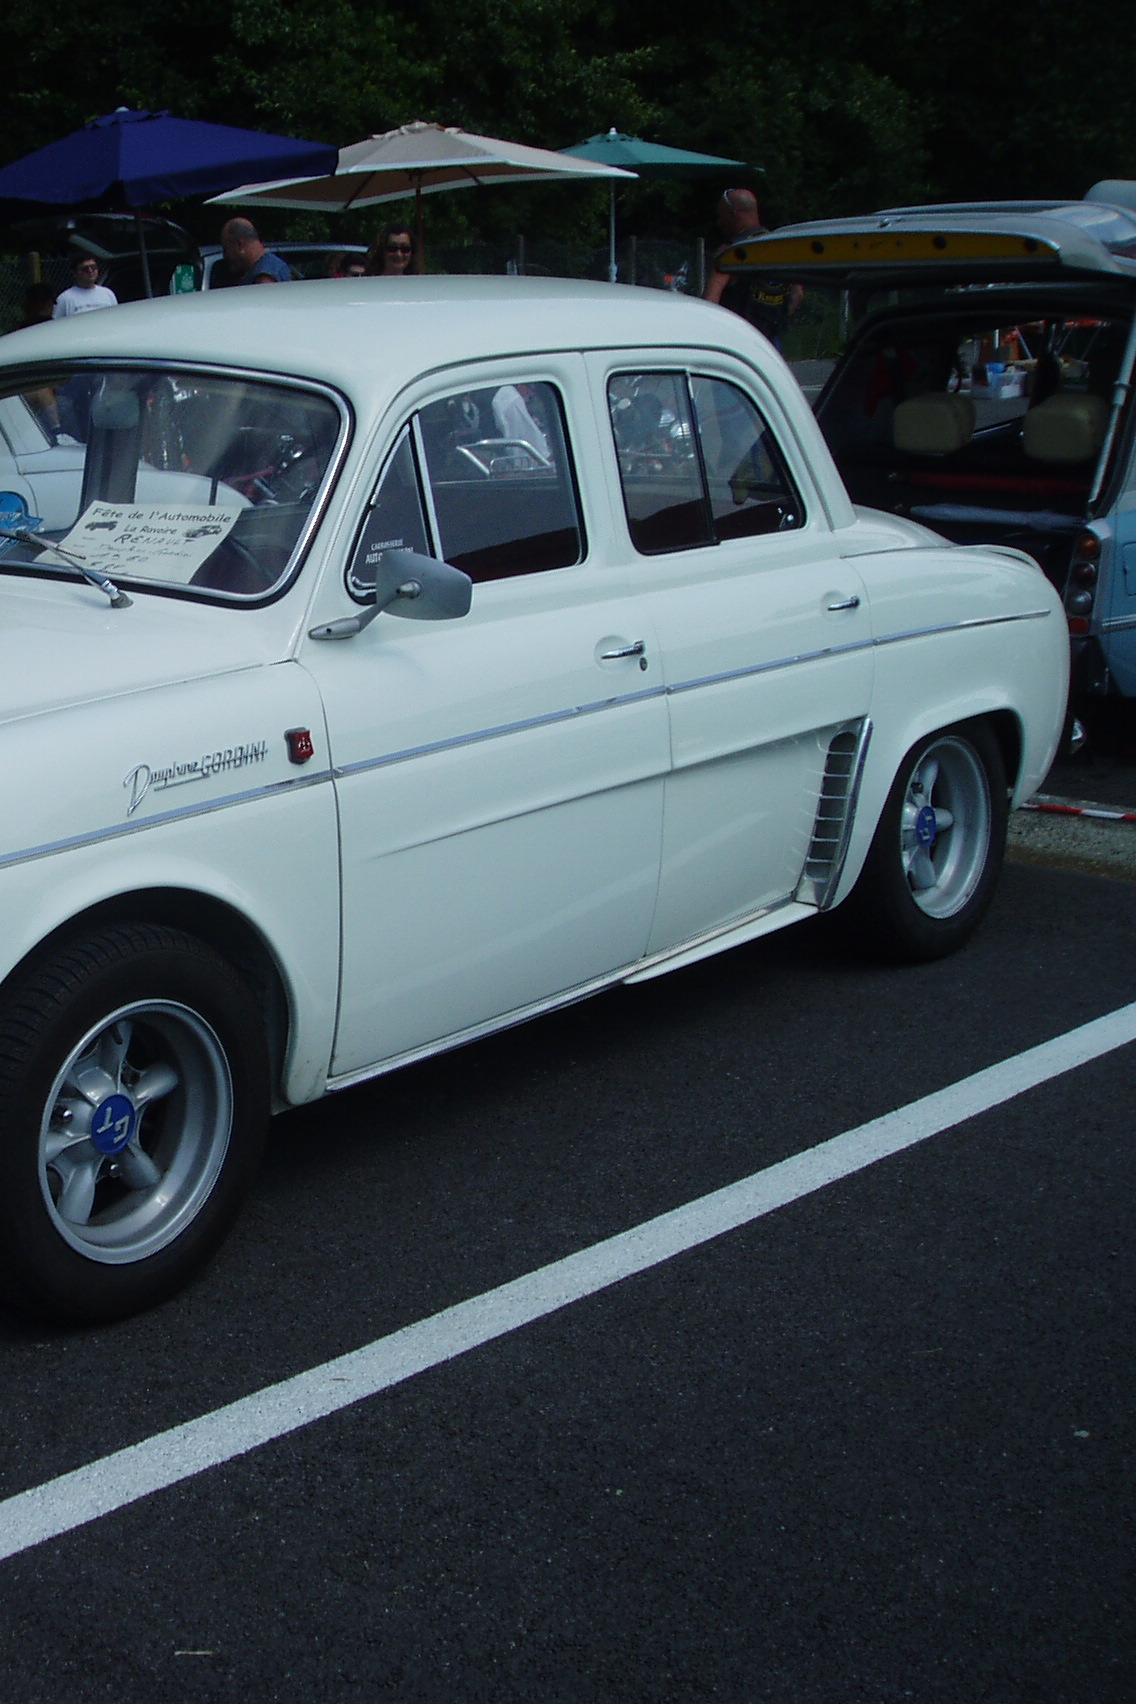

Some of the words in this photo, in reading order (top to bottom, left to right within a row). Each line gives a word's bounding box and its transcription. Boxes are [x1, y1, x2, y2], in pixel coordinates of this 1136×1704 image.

[92, 507, 124, 519] Fête
[128, 510, 144, 520] de
[149, 511, 231, 523] l'Automobile
[113, 533, 195, 545] RENAULT
[123, 761, 201, 817] Dauphine
[200, 740, 268, 775] GORDINI
